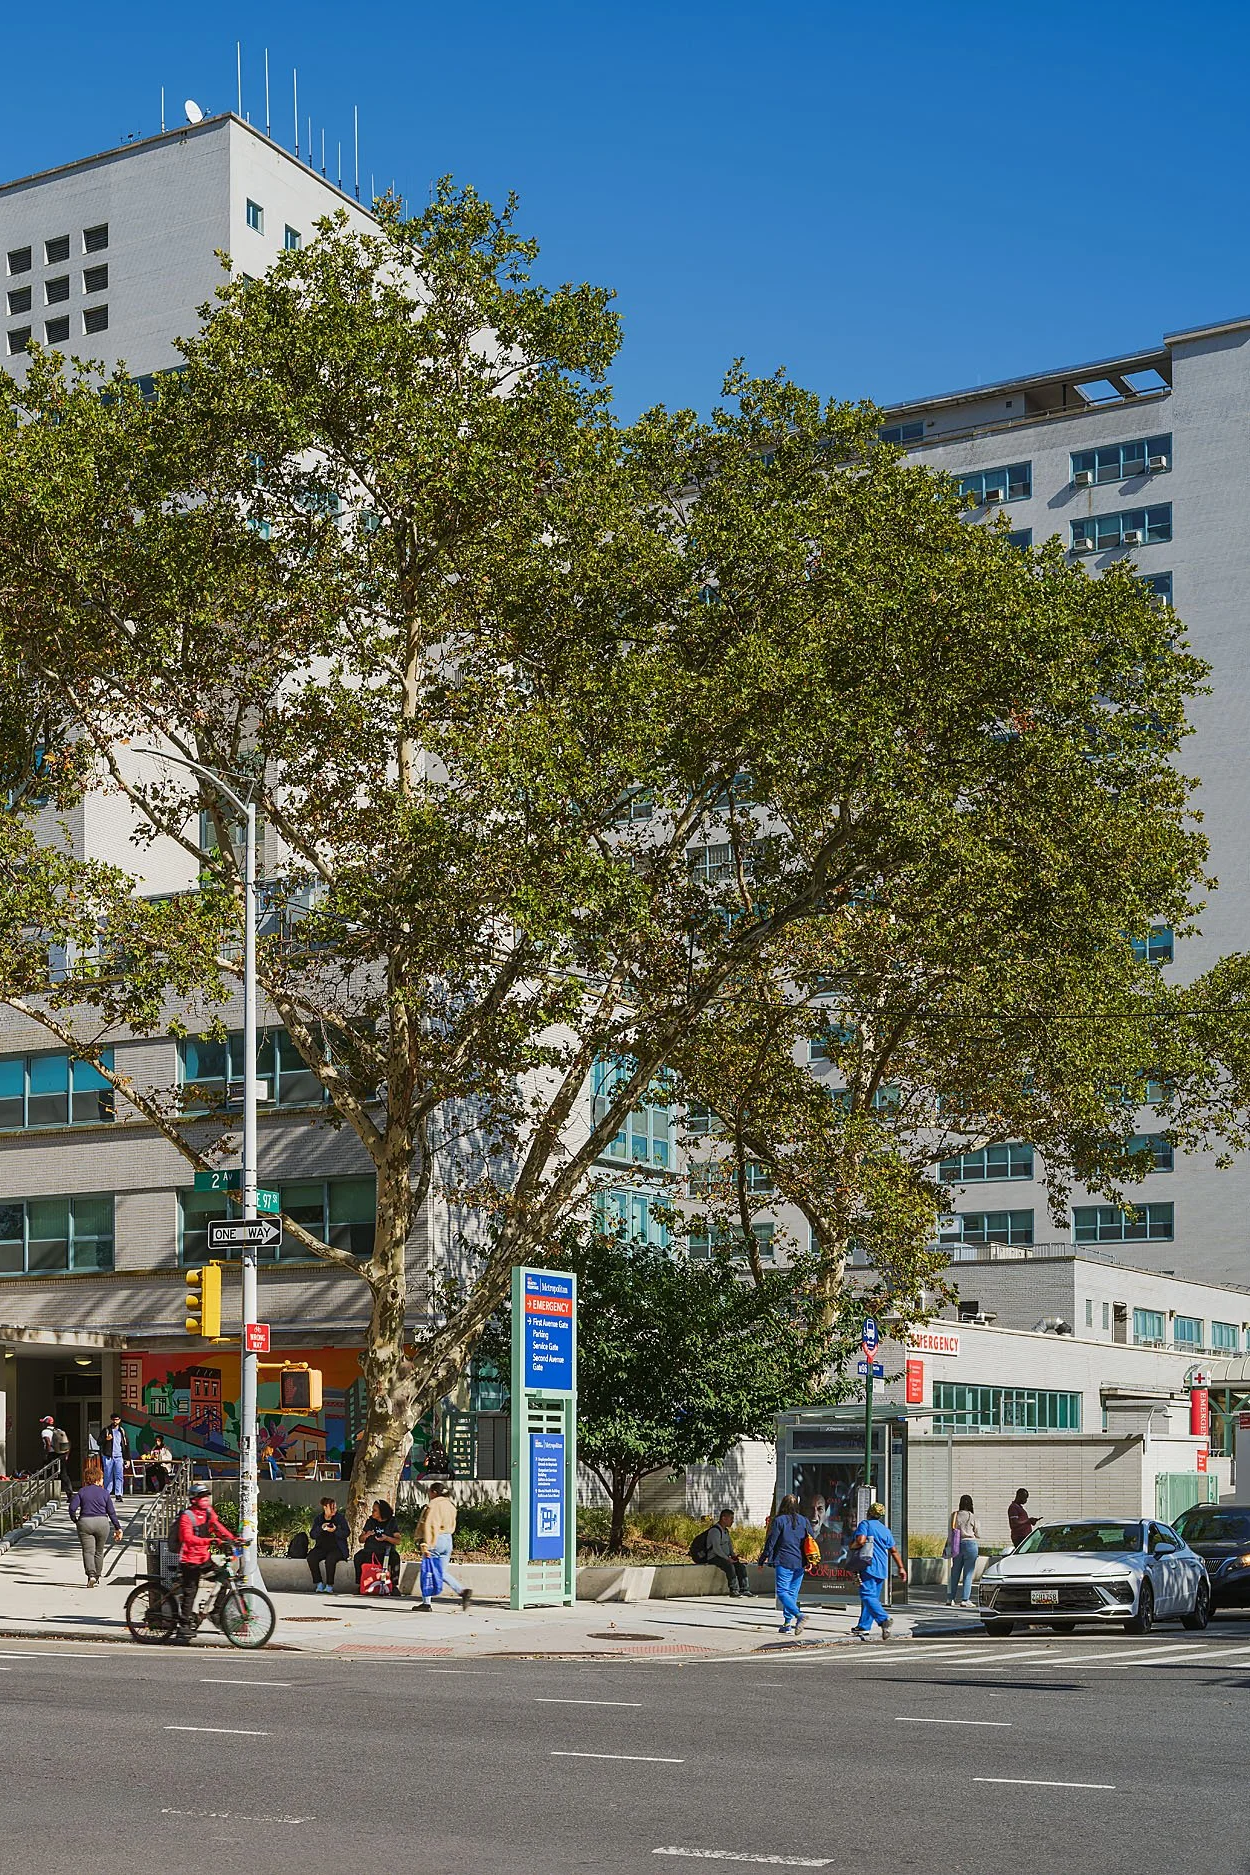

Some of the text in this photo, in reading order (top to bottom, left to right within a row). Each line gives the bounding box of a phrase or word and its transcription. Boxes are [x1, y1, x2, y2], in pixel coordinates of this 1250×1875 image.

[211, 1171, 233, 1189] 2 Av
[256, 1192, 278, 1209] E 97 St
[215, 1226, 271, 1240] ONE WAY
[533, 1300, 569, 1313] EMERGENCY
[533, 1318, 569, 1329] First Avenue Gate
[250, 1334, 266, 1342] WRONG
[533, 1330, 549, 1341] Parking
[253, 1341, 263, 1349] WAY
[533, 1341, 559, 1351] Service Gate
[533, 1353, 565, 1364] Second Avenue
[533, 1363, 544, 1371] Gate
[809, 1568, 853, 1579] CONJURIN
